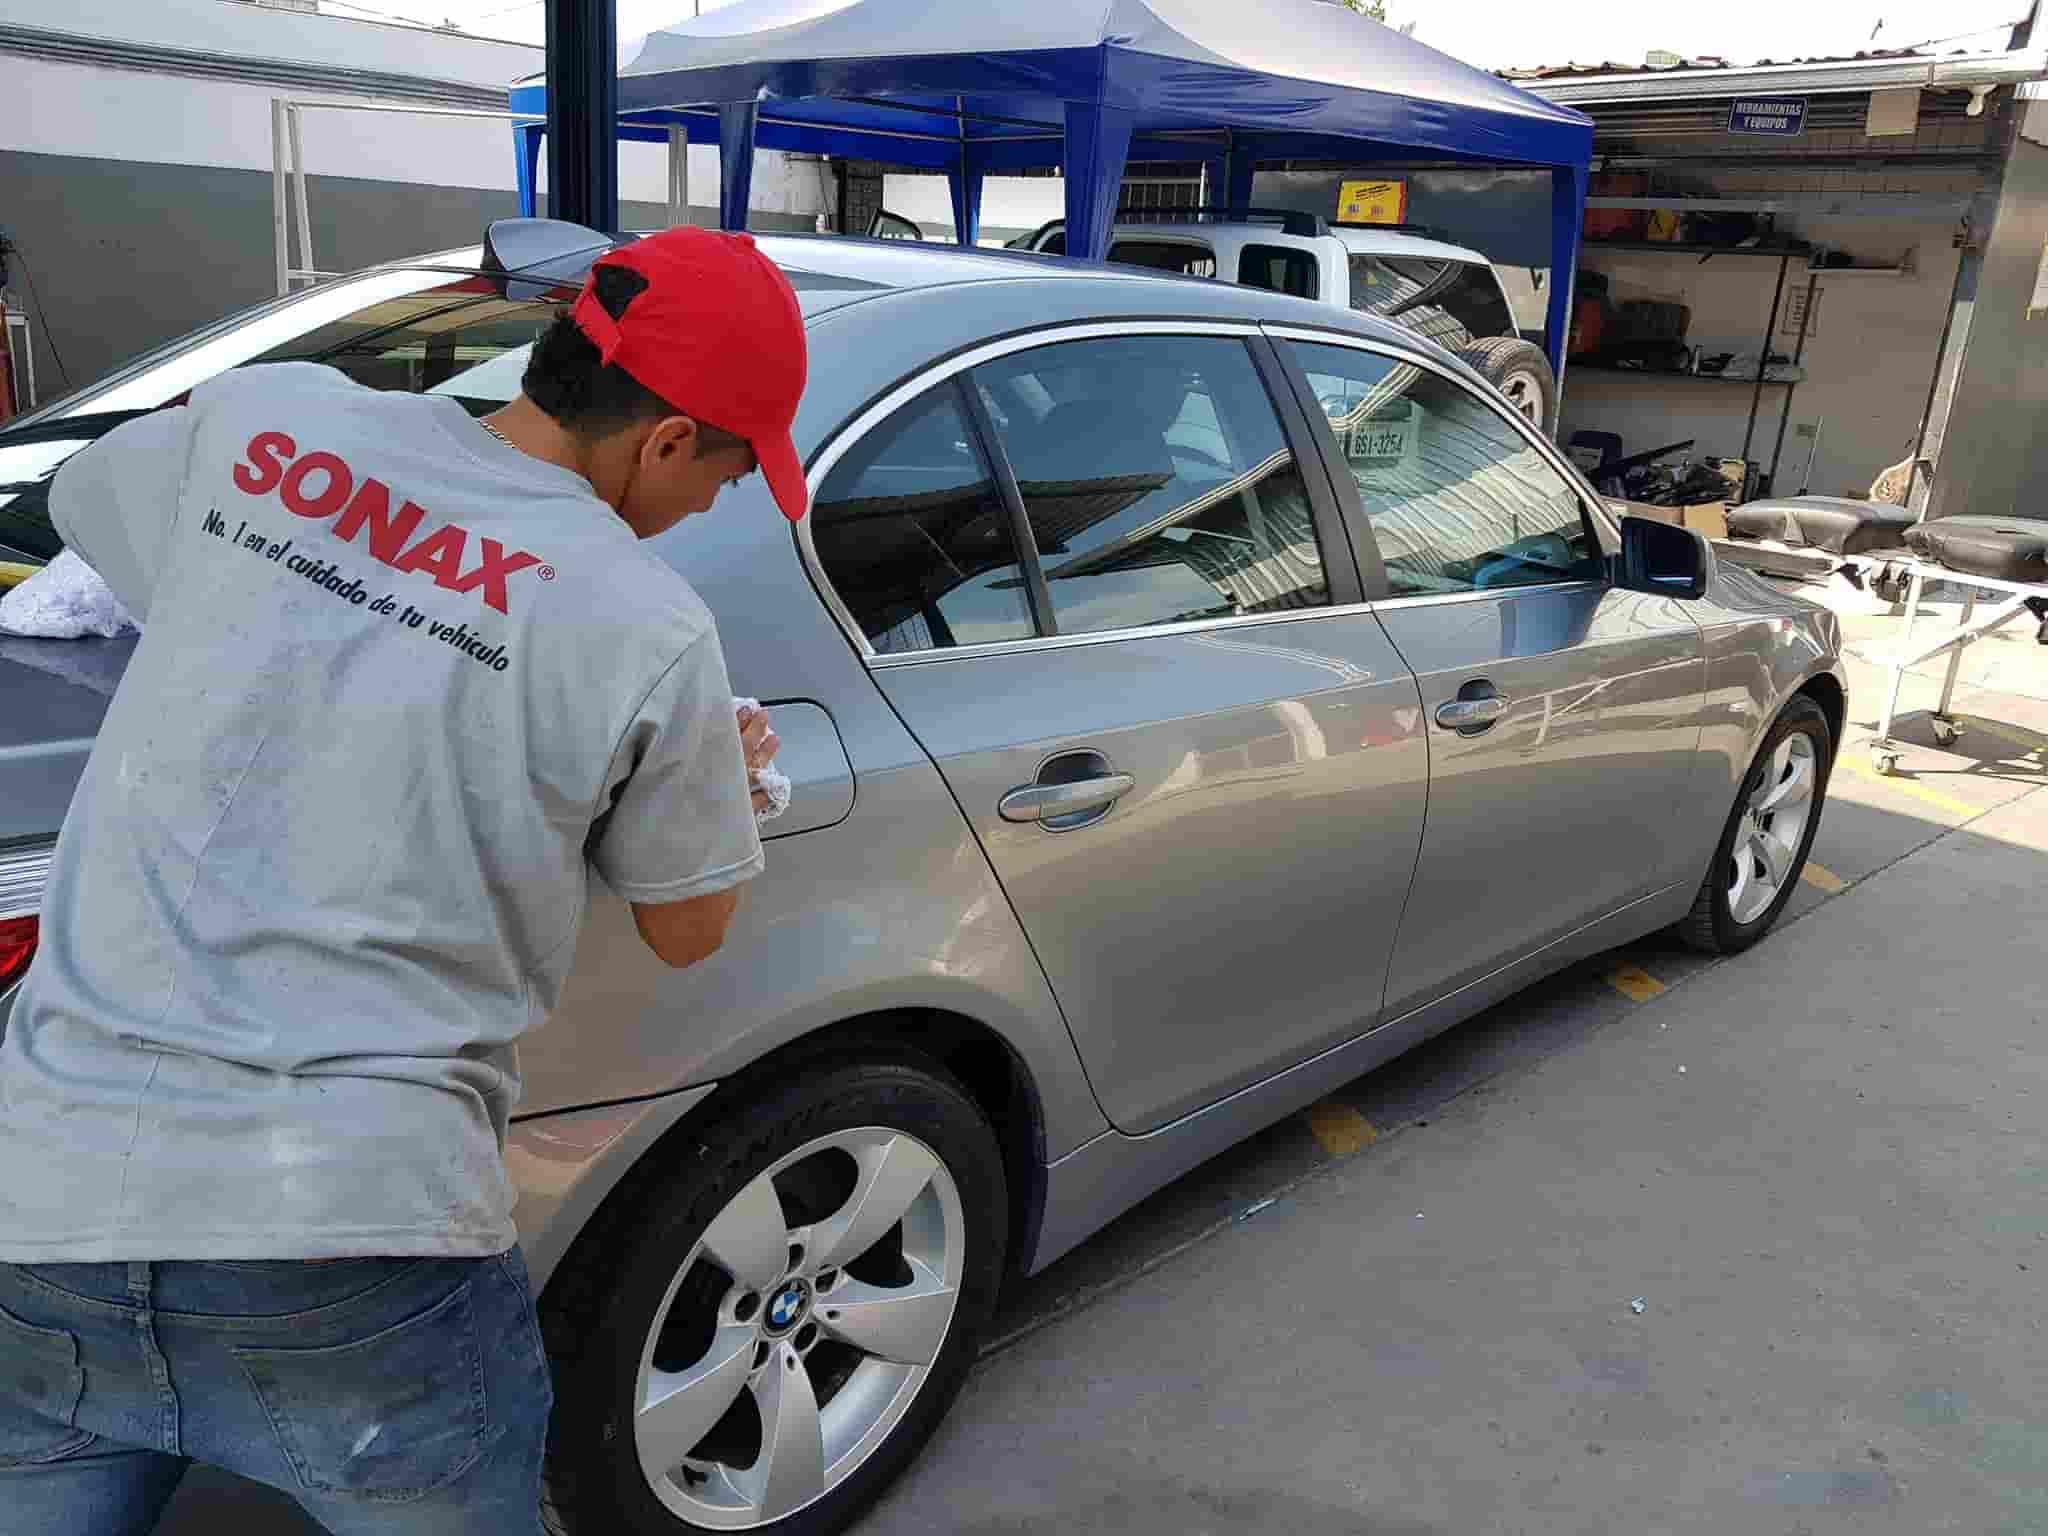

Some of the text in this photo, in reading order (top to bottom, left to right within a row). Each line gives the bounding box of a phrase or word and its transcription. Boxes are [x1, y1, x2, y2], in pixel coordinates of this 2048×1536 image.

[1751, 117, 1788, 129] EQUIPOS
[201, 508, 225, 538] No.
[243, 533, 267, 552] en
[266, 540, 292, 562] el
[286, 554, 367, 604] cuidado
[368, 594, 397, 615] de
[399, 605, 425, 628] tu
[427, 623, 509, 671] vehículo
[233, 431, 543, 616] SONAX
